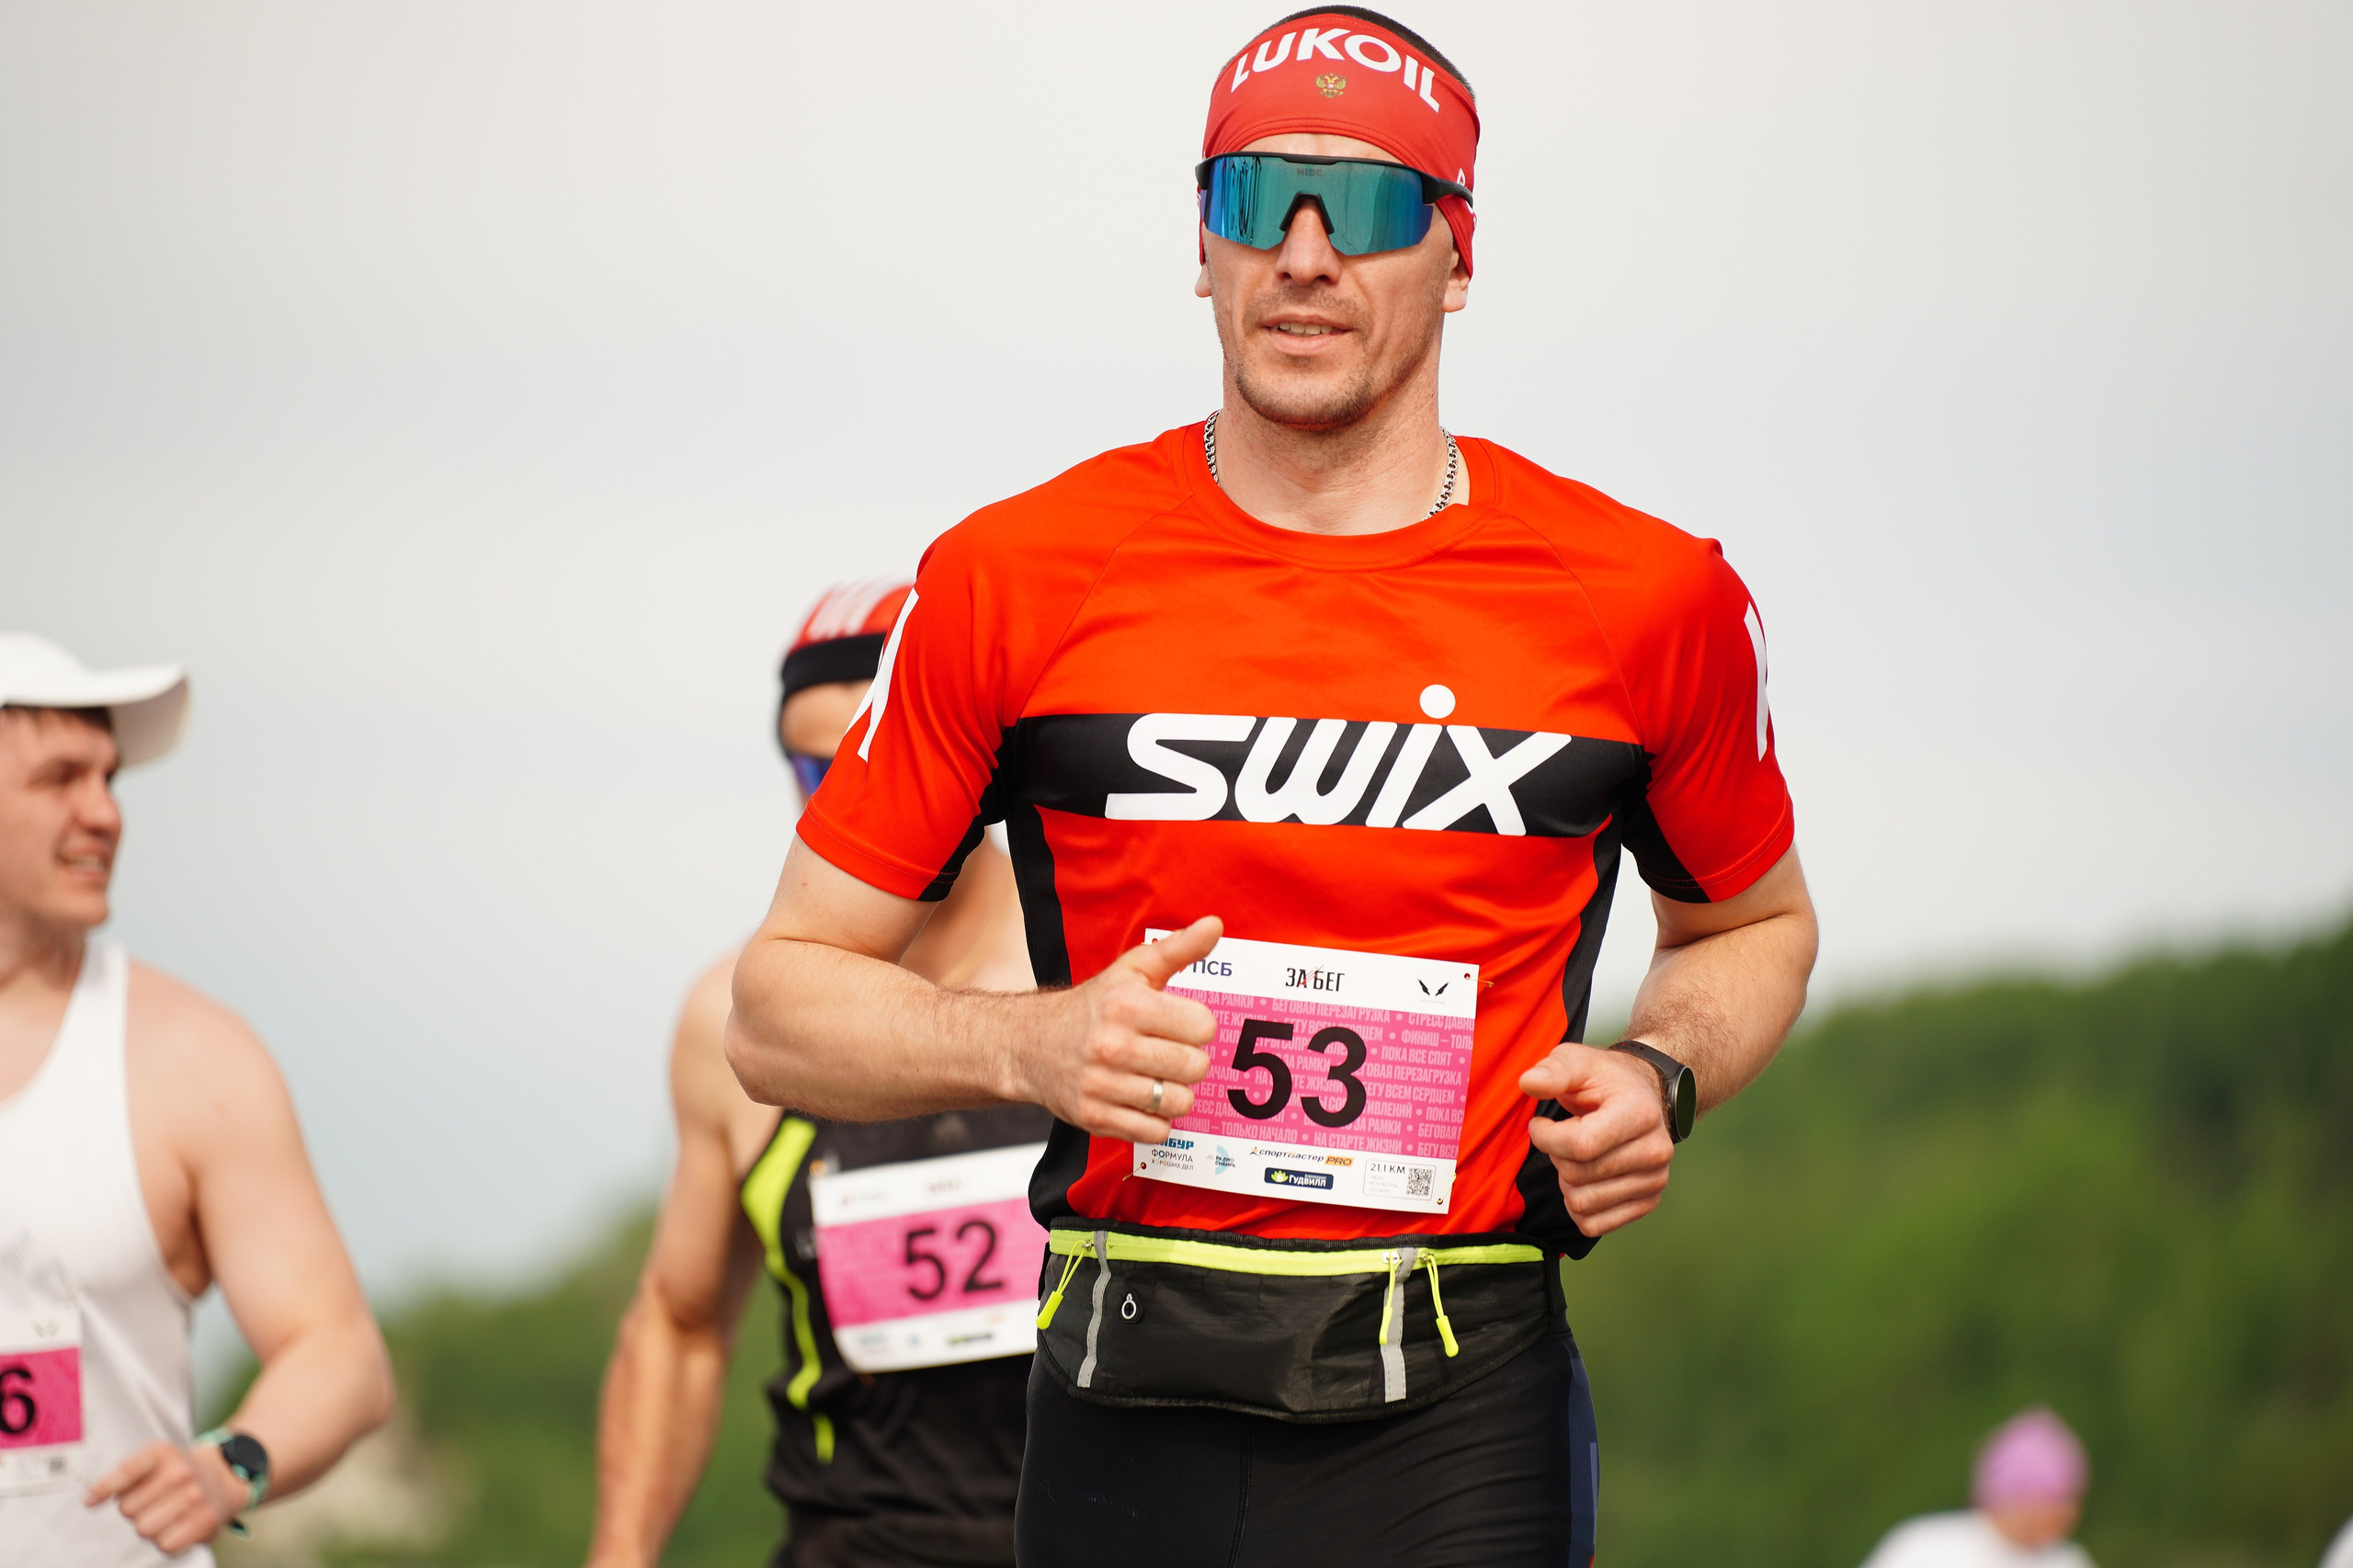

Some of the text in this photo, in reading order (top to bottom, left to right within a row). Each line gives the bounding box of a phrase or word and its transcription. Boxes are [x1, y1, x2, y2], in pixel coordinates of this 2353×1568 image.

[1232, 28, 1439, 113] LUKOIL
[1297, 168, 1323, 177] HIDE
[1192, 959, 1233, 976] ПСБ
[1222, 993, 1255, 1008] РАМКИ
[1272, 999, 1315, 1014] БЕГОВАЯ
[1316, 1003, 1390, 1023] ПЕРЕЗАГРУЗКА
[1408, 1012, 1444, 1028] СТРЕСС
[1402, 1028, 1439, 1047] ФИНИШ
[1381, 1045, 1407, 1062] ПОКА
[1408, 1049, 1427, 1064] ВСЕ
[1427, 1051, 1452, 1066] СПЯТ
[1226, 1018, 1368, 1128] 53
[1296, 1054, 1331, 1073] РАМКИ
[1393, 1064, 1461, 1085] ПЕРЕЗАГРУЗКА
[1385, 1083, 1412, 1101] ВСЕМ
[1413, 1087, 1455, 1105] СЕРДЦЕМ
[1426, 1106, 1449, 1122] ПОКА
[1222, 1120, 1258, 1139] ТОЛЬКО
[1259, 1125, 1298, 1143] НАЧАЛО
[1313, 1131, 1328, 1147] НА
[1329, 1132, 1365, 1150] СТАРТЕ
[1365, 1136, 1402, 1154] ЖИЗНИ
[1417, 1142, 1440, 1157] БЕГУ
[1368, 1117, 1402, 1135] РАМКИ
[1418, 1122, 1457, 1140] БЕГОВАЯ
[1151, 1148, 1194, 1164] ФОРМУЛА
[1215, 1154, 1234, 1163] РАДИО
[1325, 1156, 1352, 1166] PRO
[904, 1219, 1006, 1301] 52
